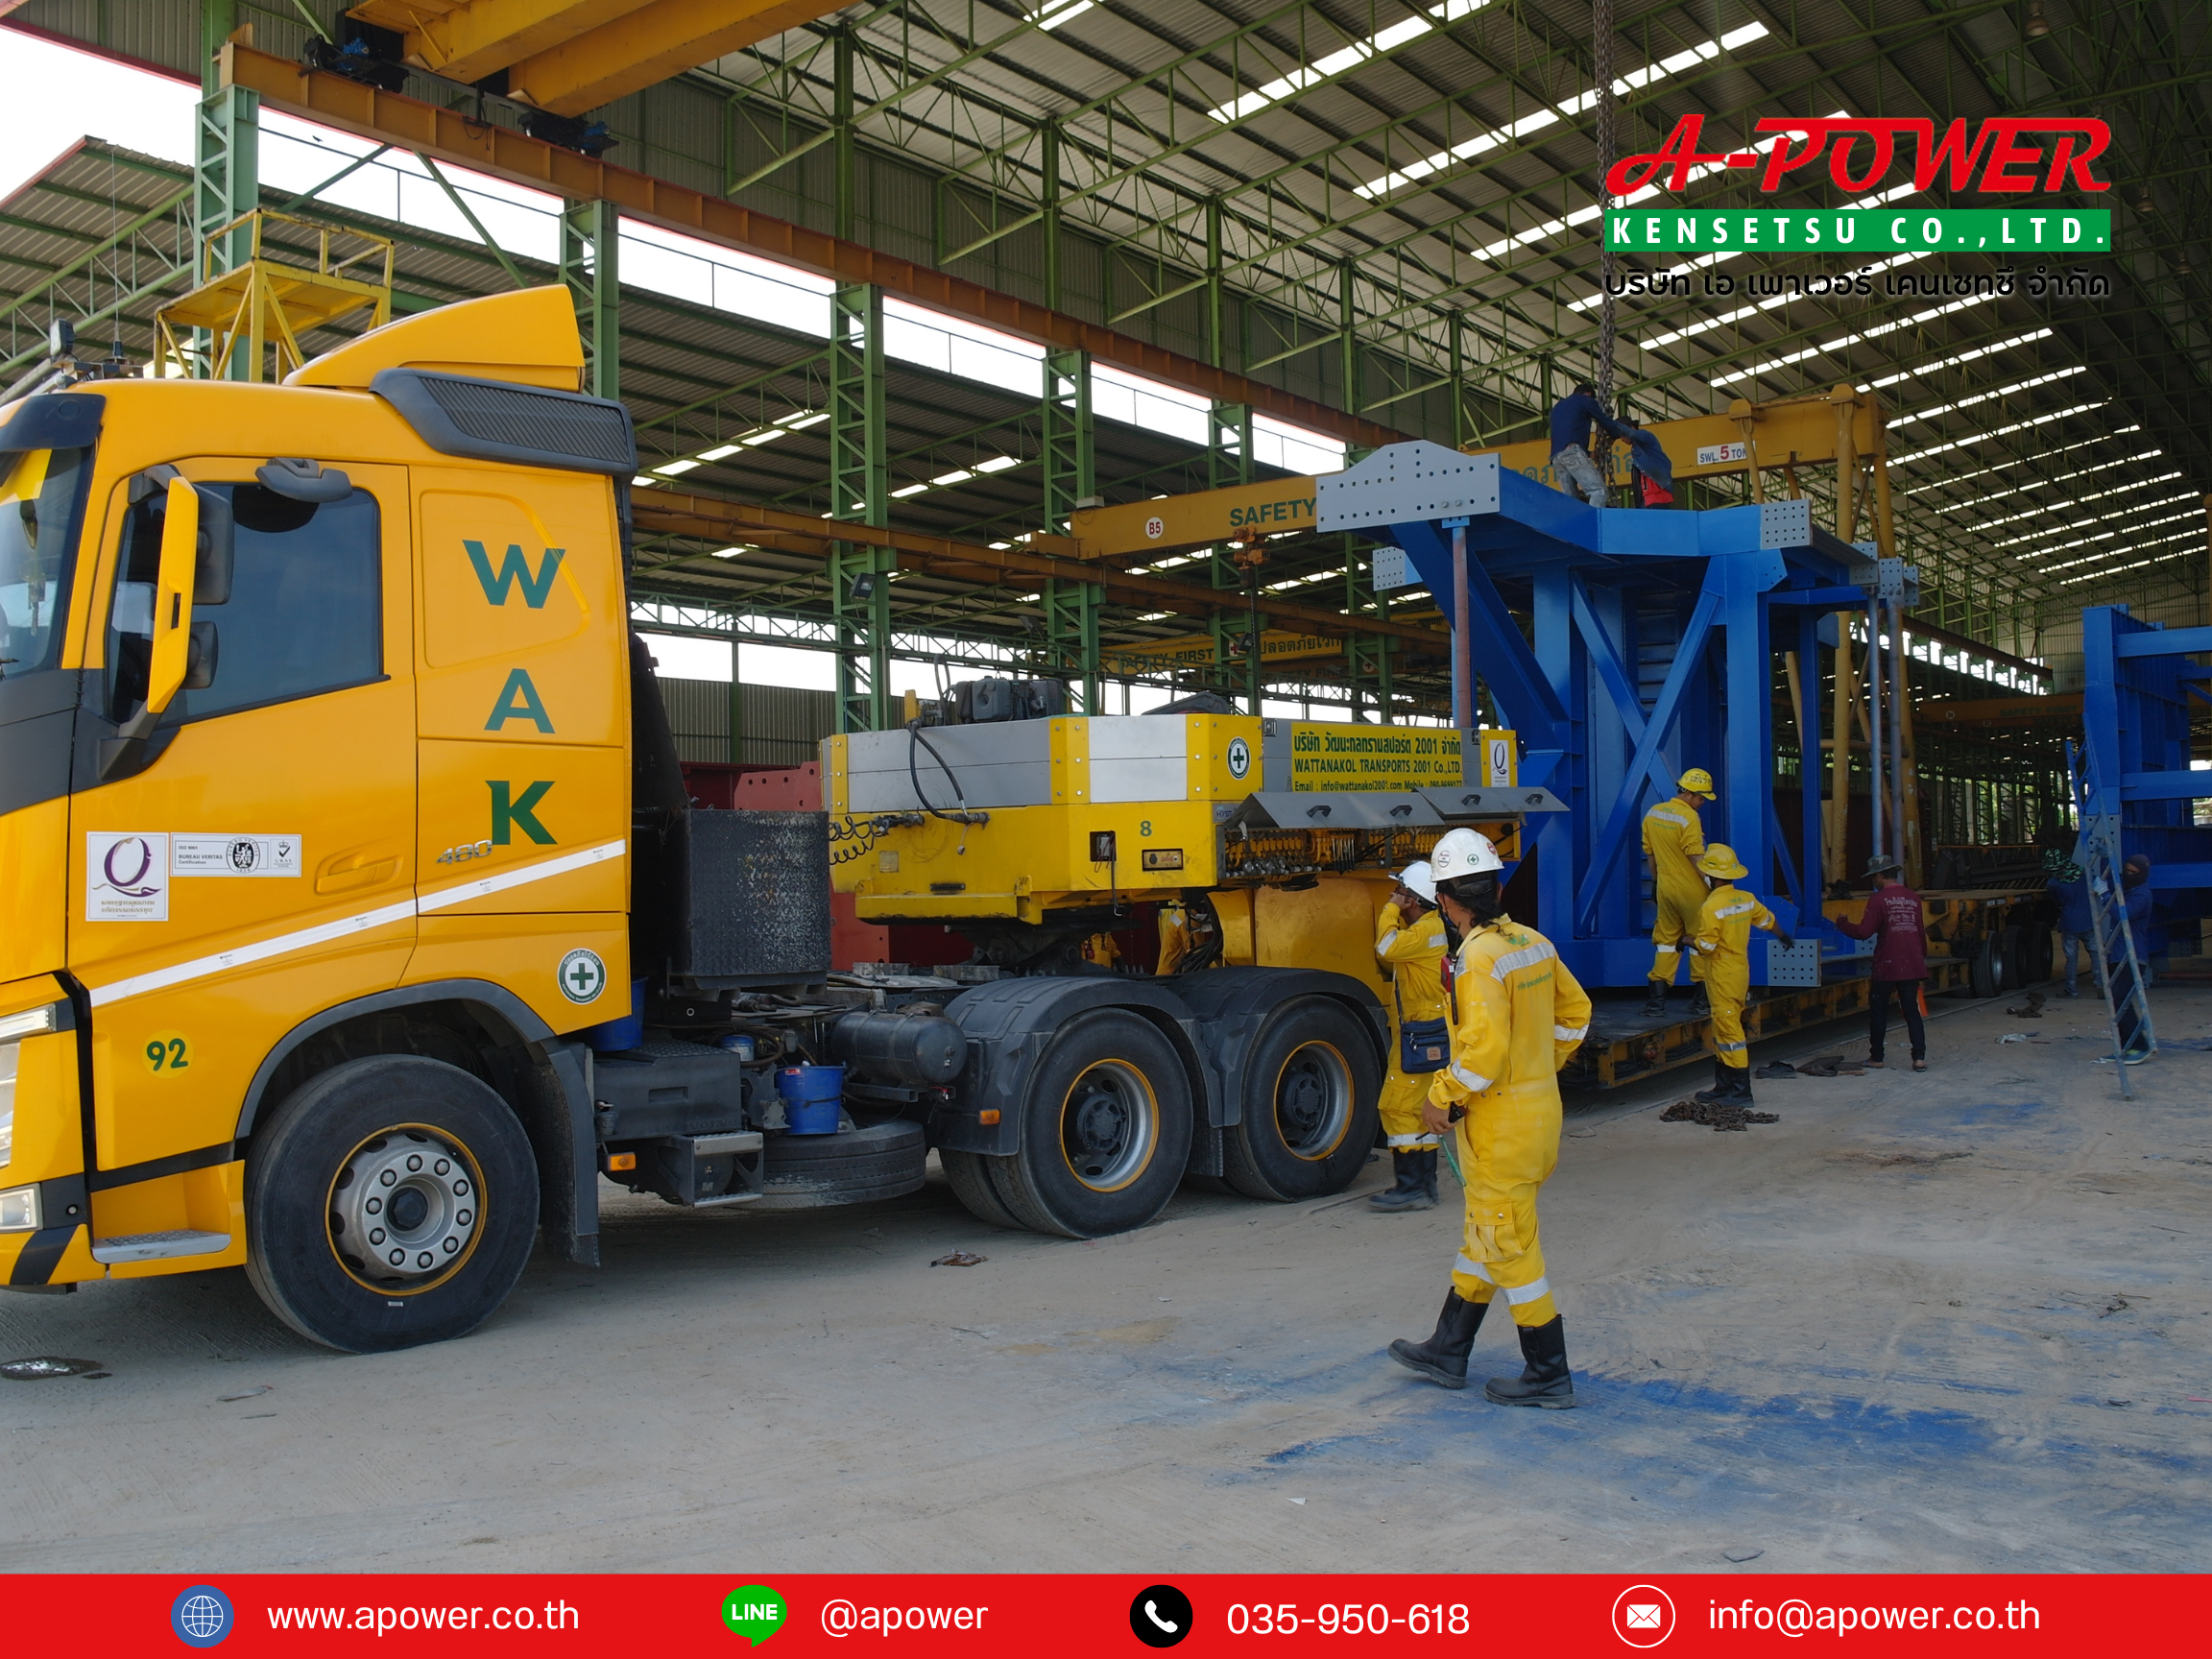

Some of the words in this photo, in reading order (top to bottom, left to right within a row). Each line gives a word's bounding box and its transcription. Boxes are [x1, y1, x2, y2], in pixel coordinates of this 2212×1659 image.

[1720, 445, 1730, 460] 5
[1229, 497, 1317, 527] SAFETY
[1148, 521, 1161, 535] B5
[1175, 648, 1214, 662] FIRST
[1294, 732, 1321, 753] บริษัท
[1416, 737, 1437, 755] 2001
[1441, 736, 1461, 756] จำกัด
[1294, 758, 1357, 773] WATTANAKOL
[1359, 758, 1410, 773] TRANSPORTS
[1413, 759, 1431, 773] 2001
[1294, 781, 1314, 791] Email
[1404, 781, 1424, 790] Mobile
[1140, 820, 1152, 837] 8
[436, 839, 493, 865] 480
[147, 1038, 189, 1071] 92
